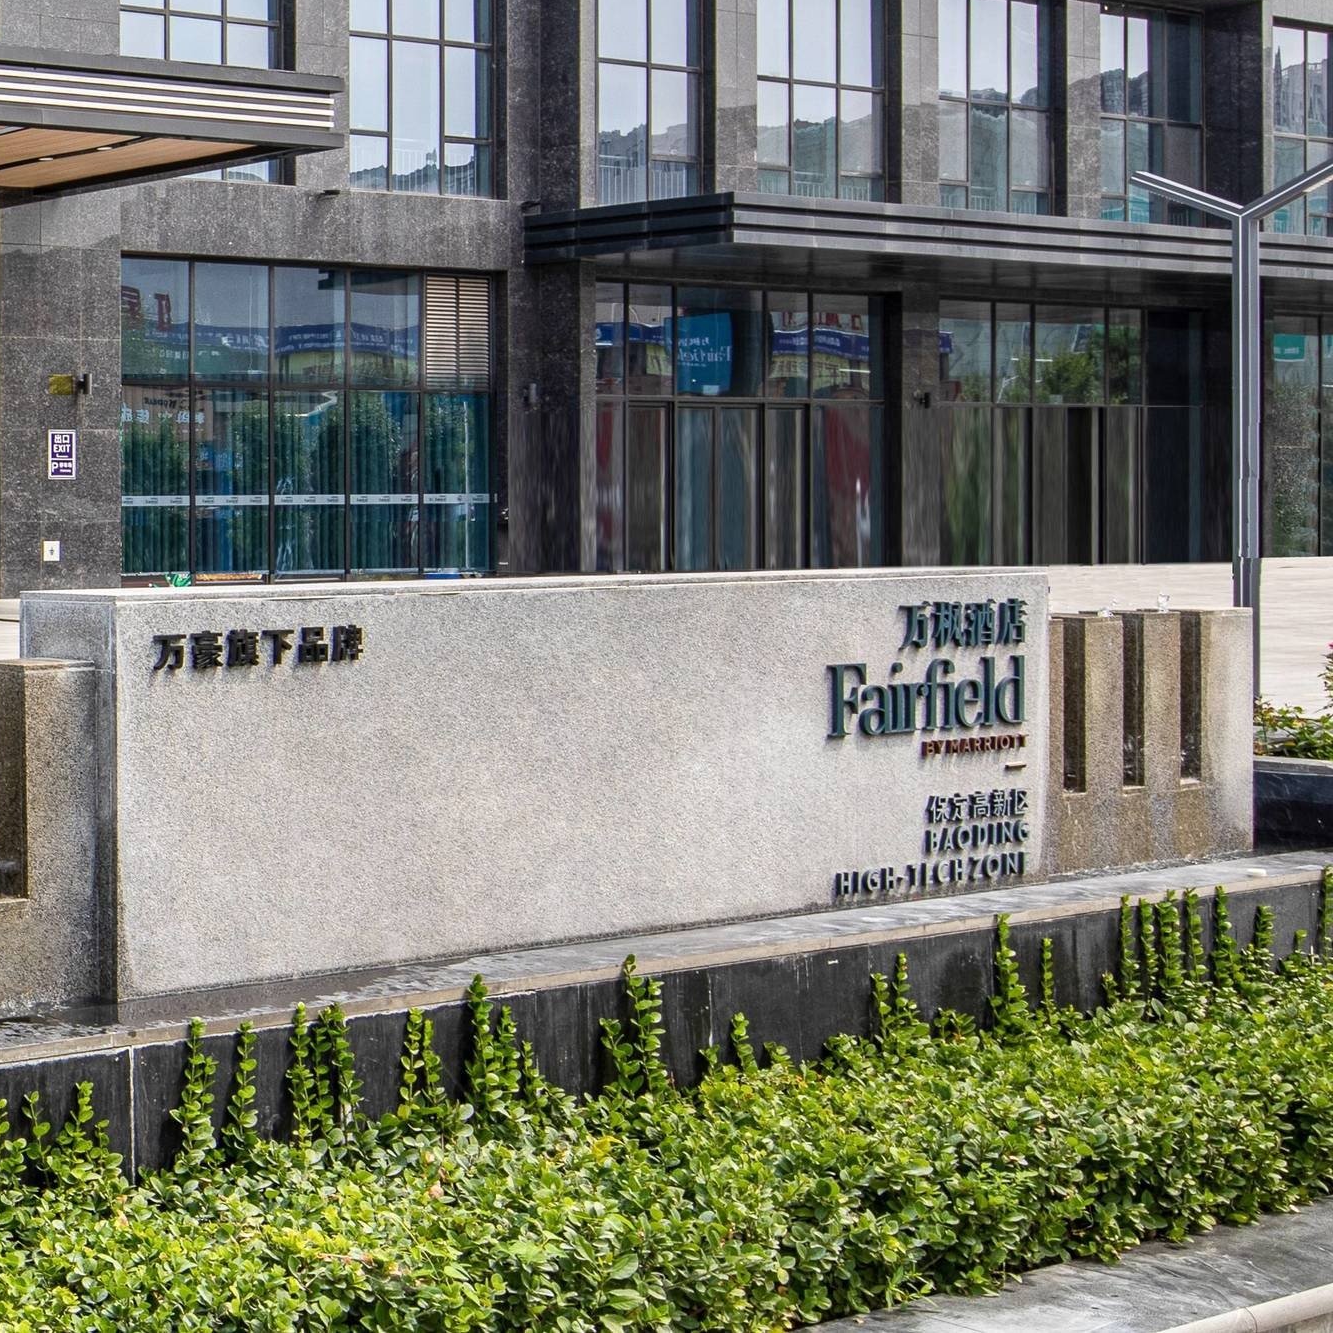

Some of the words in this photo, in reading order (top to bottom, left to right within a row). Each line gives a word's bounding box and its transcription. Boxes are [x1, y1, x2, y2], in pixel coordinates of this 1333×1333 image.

[53, 444, 71, 453] EXIT
[899, 598, 1028, 650] 万枫酒店
[152, 624, 365, 671] 万豪旗下品牌
[827, 655, 1026, 739] Fairfield
[921, 739, 947, 757] BY
[948, 733, 1028, 755] MARRIOTT
[927, 789, 1030, 823] 保定高新区
[925, 819, 1030, 854] BAODING
